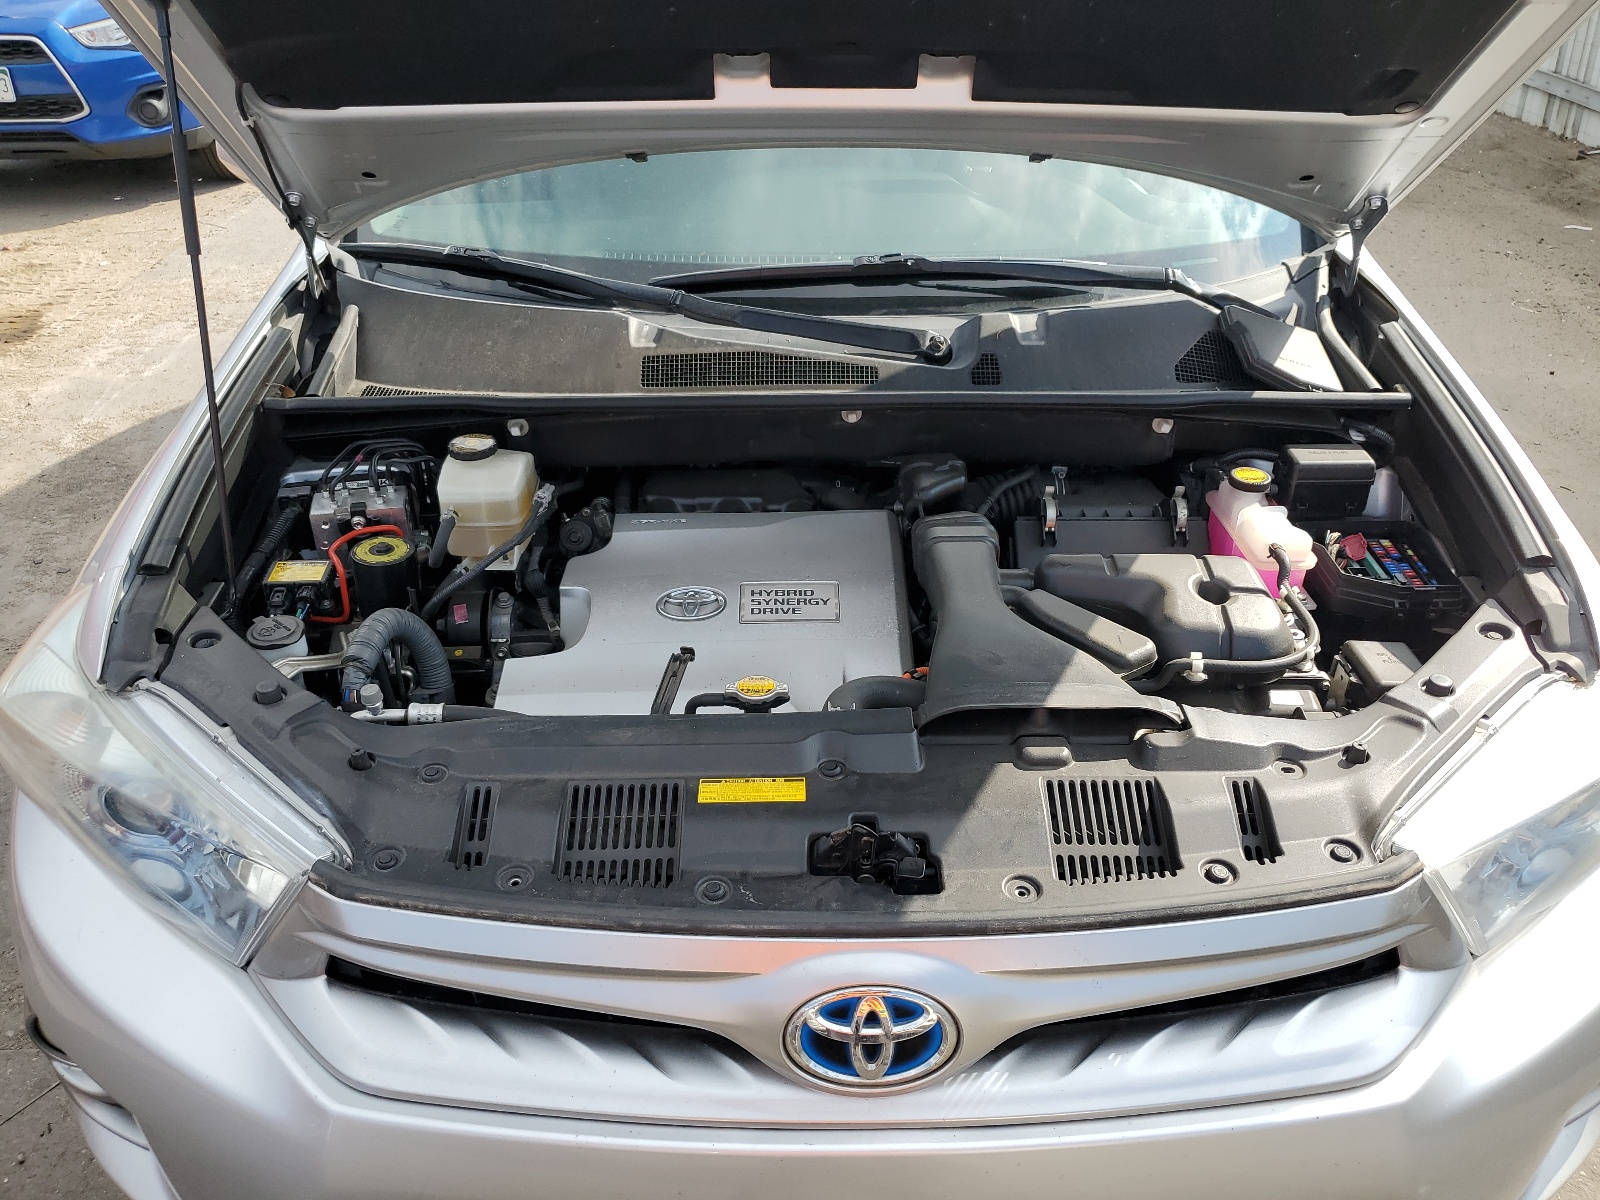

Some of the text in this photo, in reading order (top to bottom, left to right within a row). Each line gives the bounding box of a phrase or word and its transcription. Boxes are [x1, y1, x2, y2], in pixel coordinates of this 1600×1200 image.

[750, 589, 815, 597] HYBRID
[750, 598, 831, 606] SYNERGY
[750, 607, 802, 615] DRIVE
